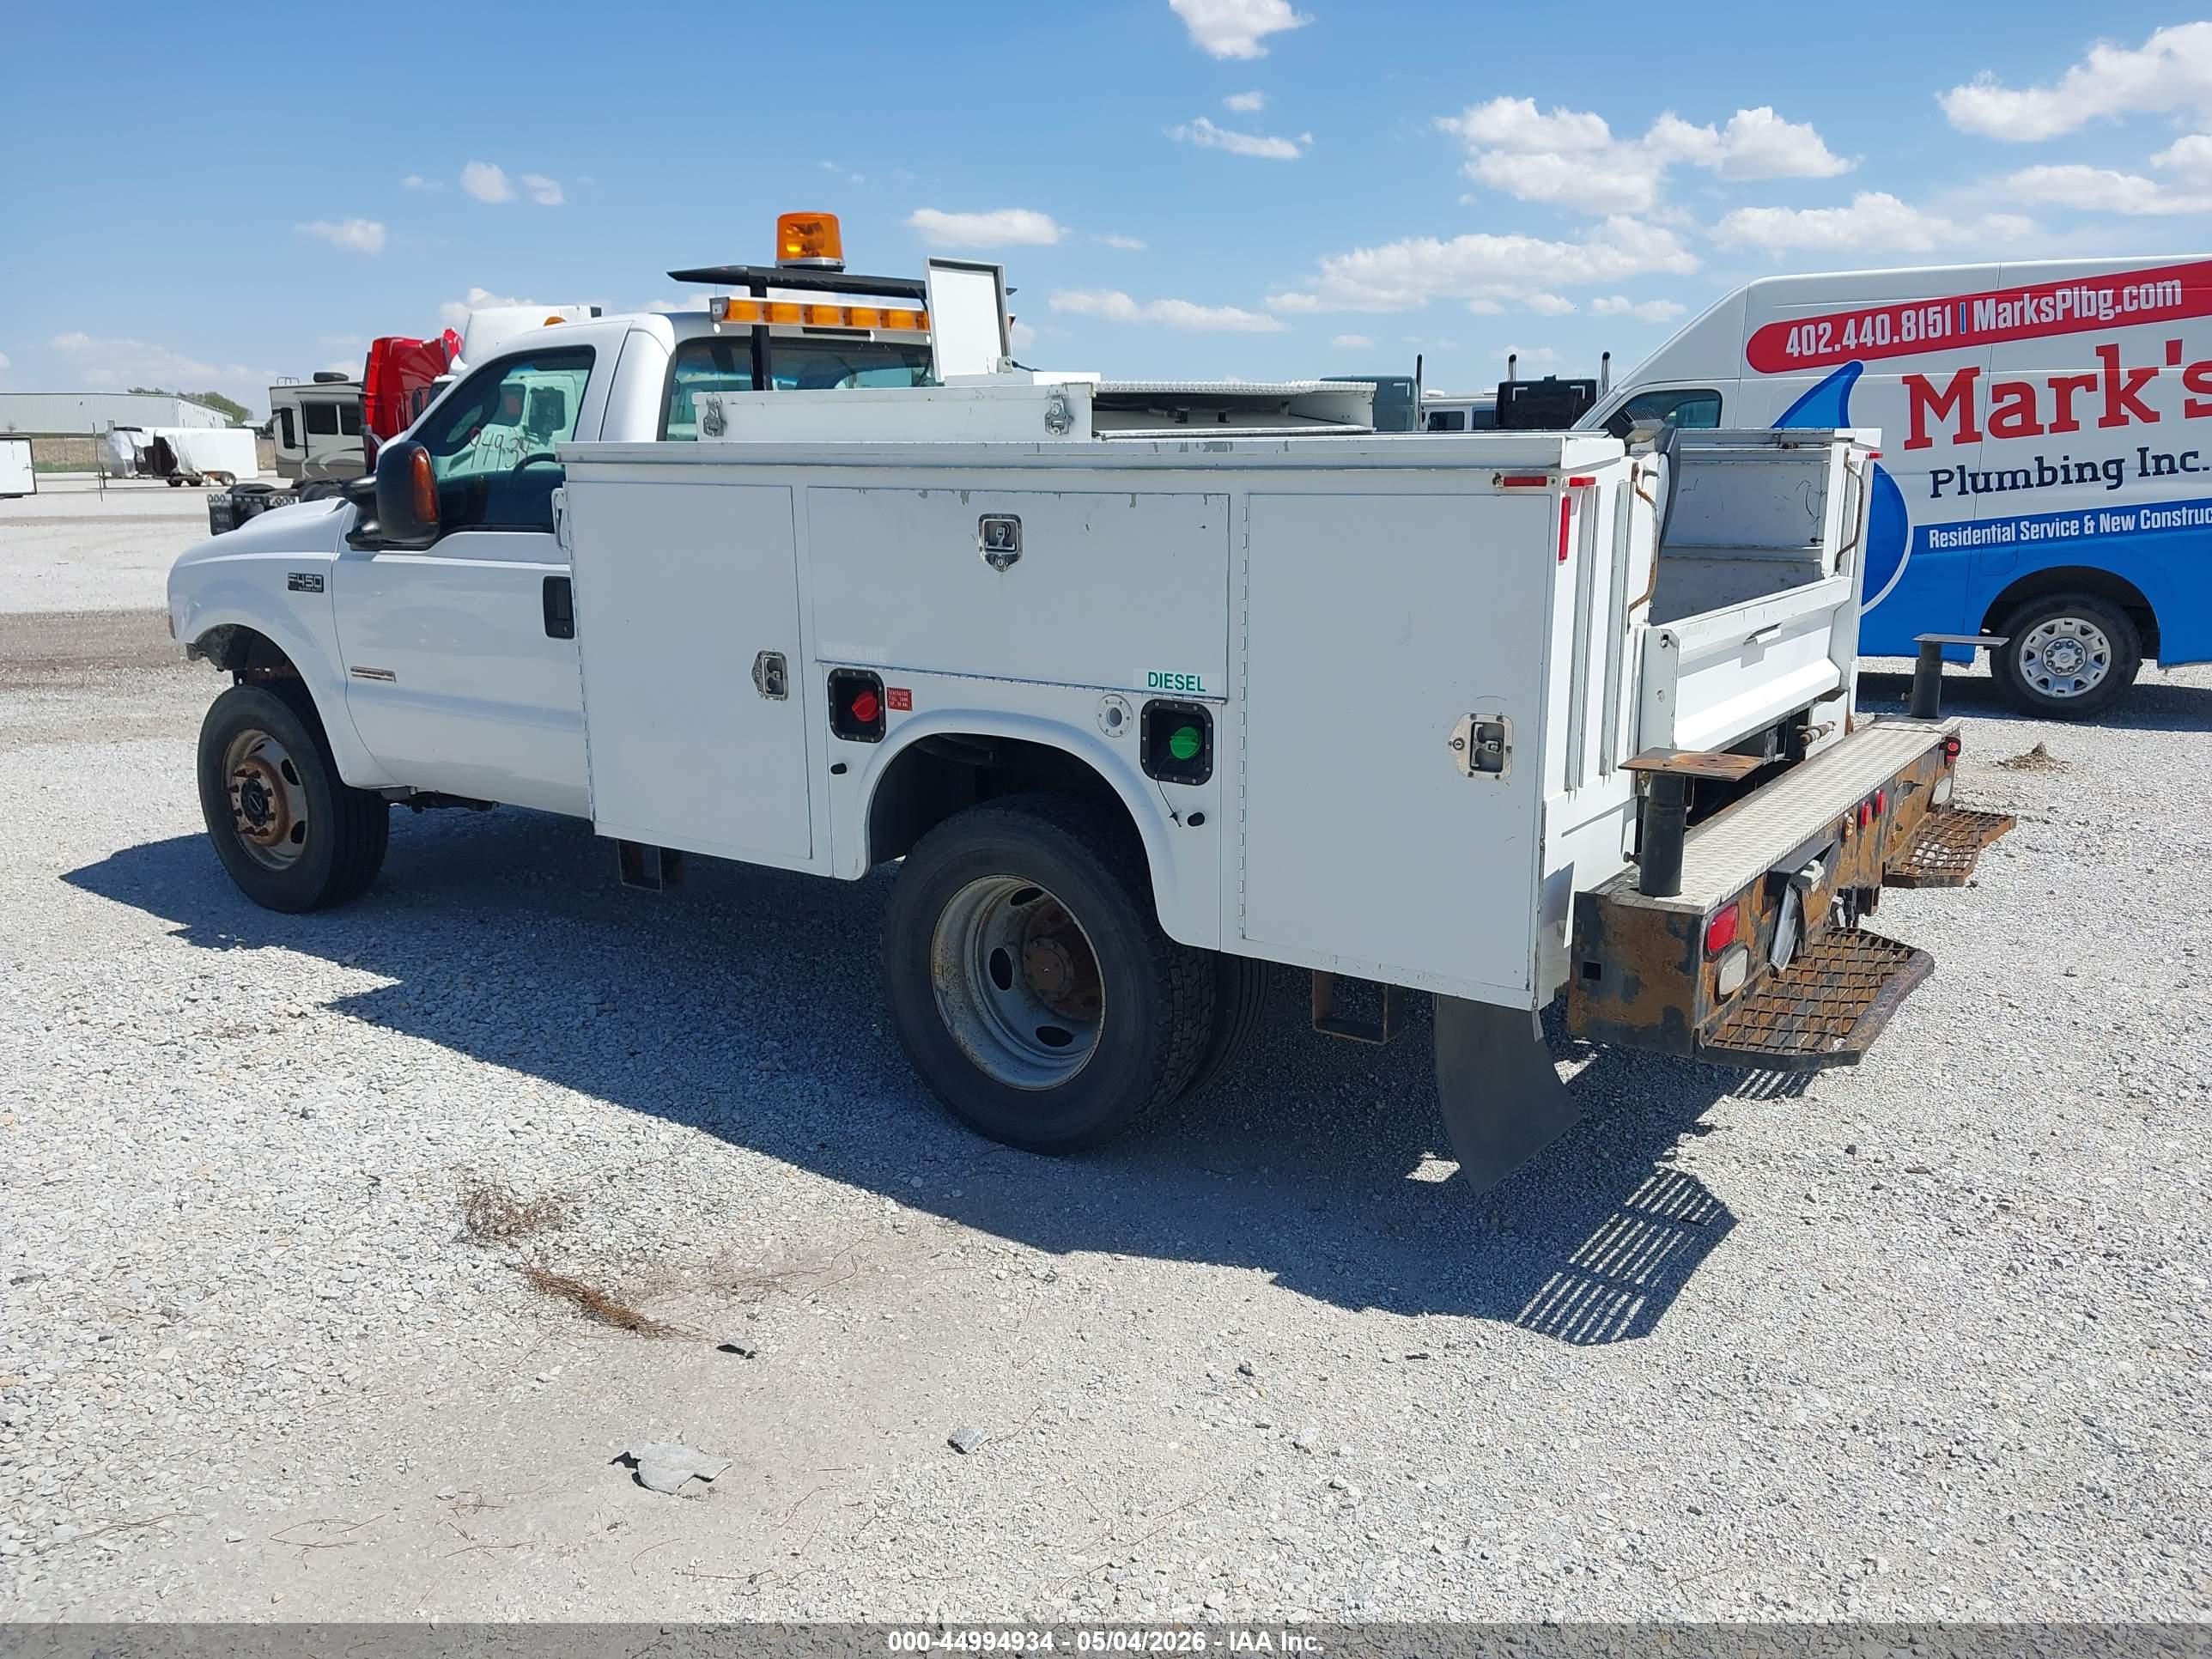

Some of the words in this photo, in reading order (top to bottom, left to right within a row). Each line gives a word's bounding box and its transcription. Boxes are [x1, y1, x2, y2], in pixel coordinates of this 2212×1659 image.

[1785, 303, 1952, 358] 402.440.8151
[1973, 278, 2182, 331] MarksPlbg.com
[1902, 338, 2212, 450] Mark's
[1929, 455, 2125, 498] Plumbing
[2137, 447, 2210, 477] Inc.
[1929, 523, 2015, 549] Residential
[2020, 518, 2080, 541] Service
[2084, 514, 2095, 534] &
[2100, 512, 2136, 532] New
[2140, 507, 2212, 529] Construc
[1148, 672, 1206, 692] DIESEL
